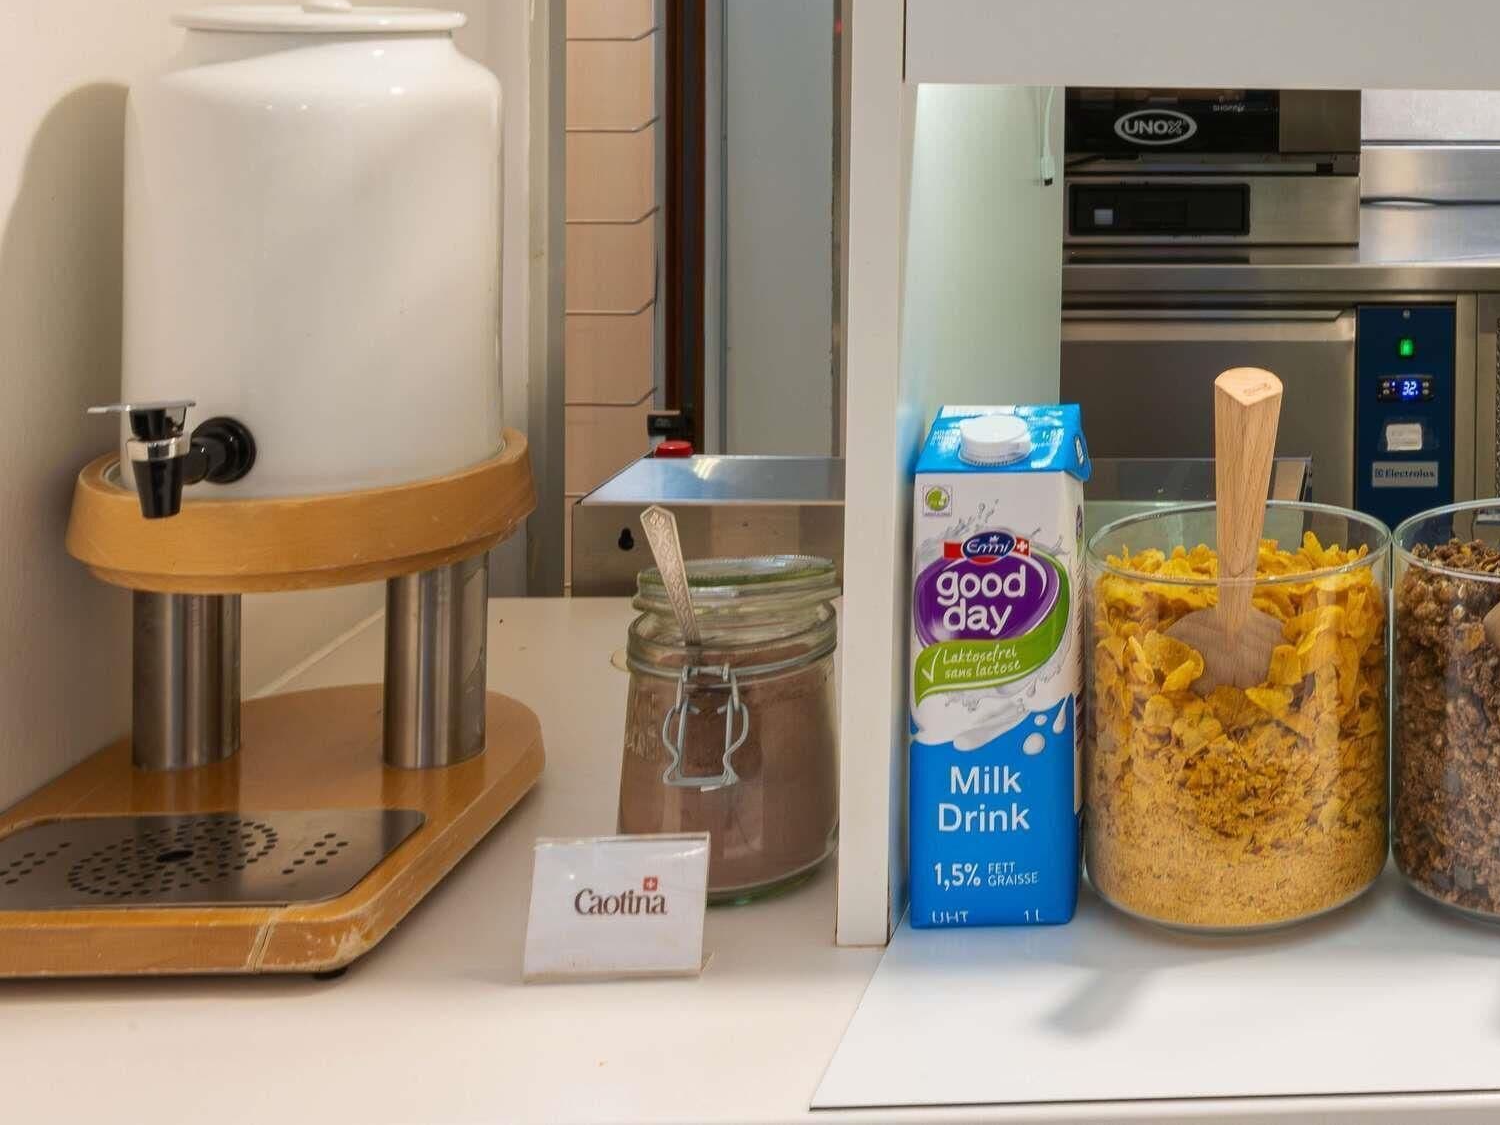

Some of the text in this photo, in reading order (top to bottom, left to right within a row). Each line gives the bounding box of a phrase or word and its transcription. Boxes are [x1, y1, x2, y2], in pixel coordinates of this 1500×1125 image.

[1124, 119, 1184, 135] UNOX
[966, 537, 1009, 555] Emmi
[936, 564, 1027, 606] good
[942, 598, 1013, 636] day
[943, 643, 1017, 665] Laktosefrei
[944, 660, 1022, 680] sans lactose
[950, 765, 1022, 795] Milk
[938, 802, 1031, 833] Drink
[933, 862, 982, 892] 1,5%
[987, 861, 1016, 874] FETT
[987, 872, 1039, 888] GRAISSE
[574, 887, 668, 916] Caotina
[932, 909, 969, 924] UHT
